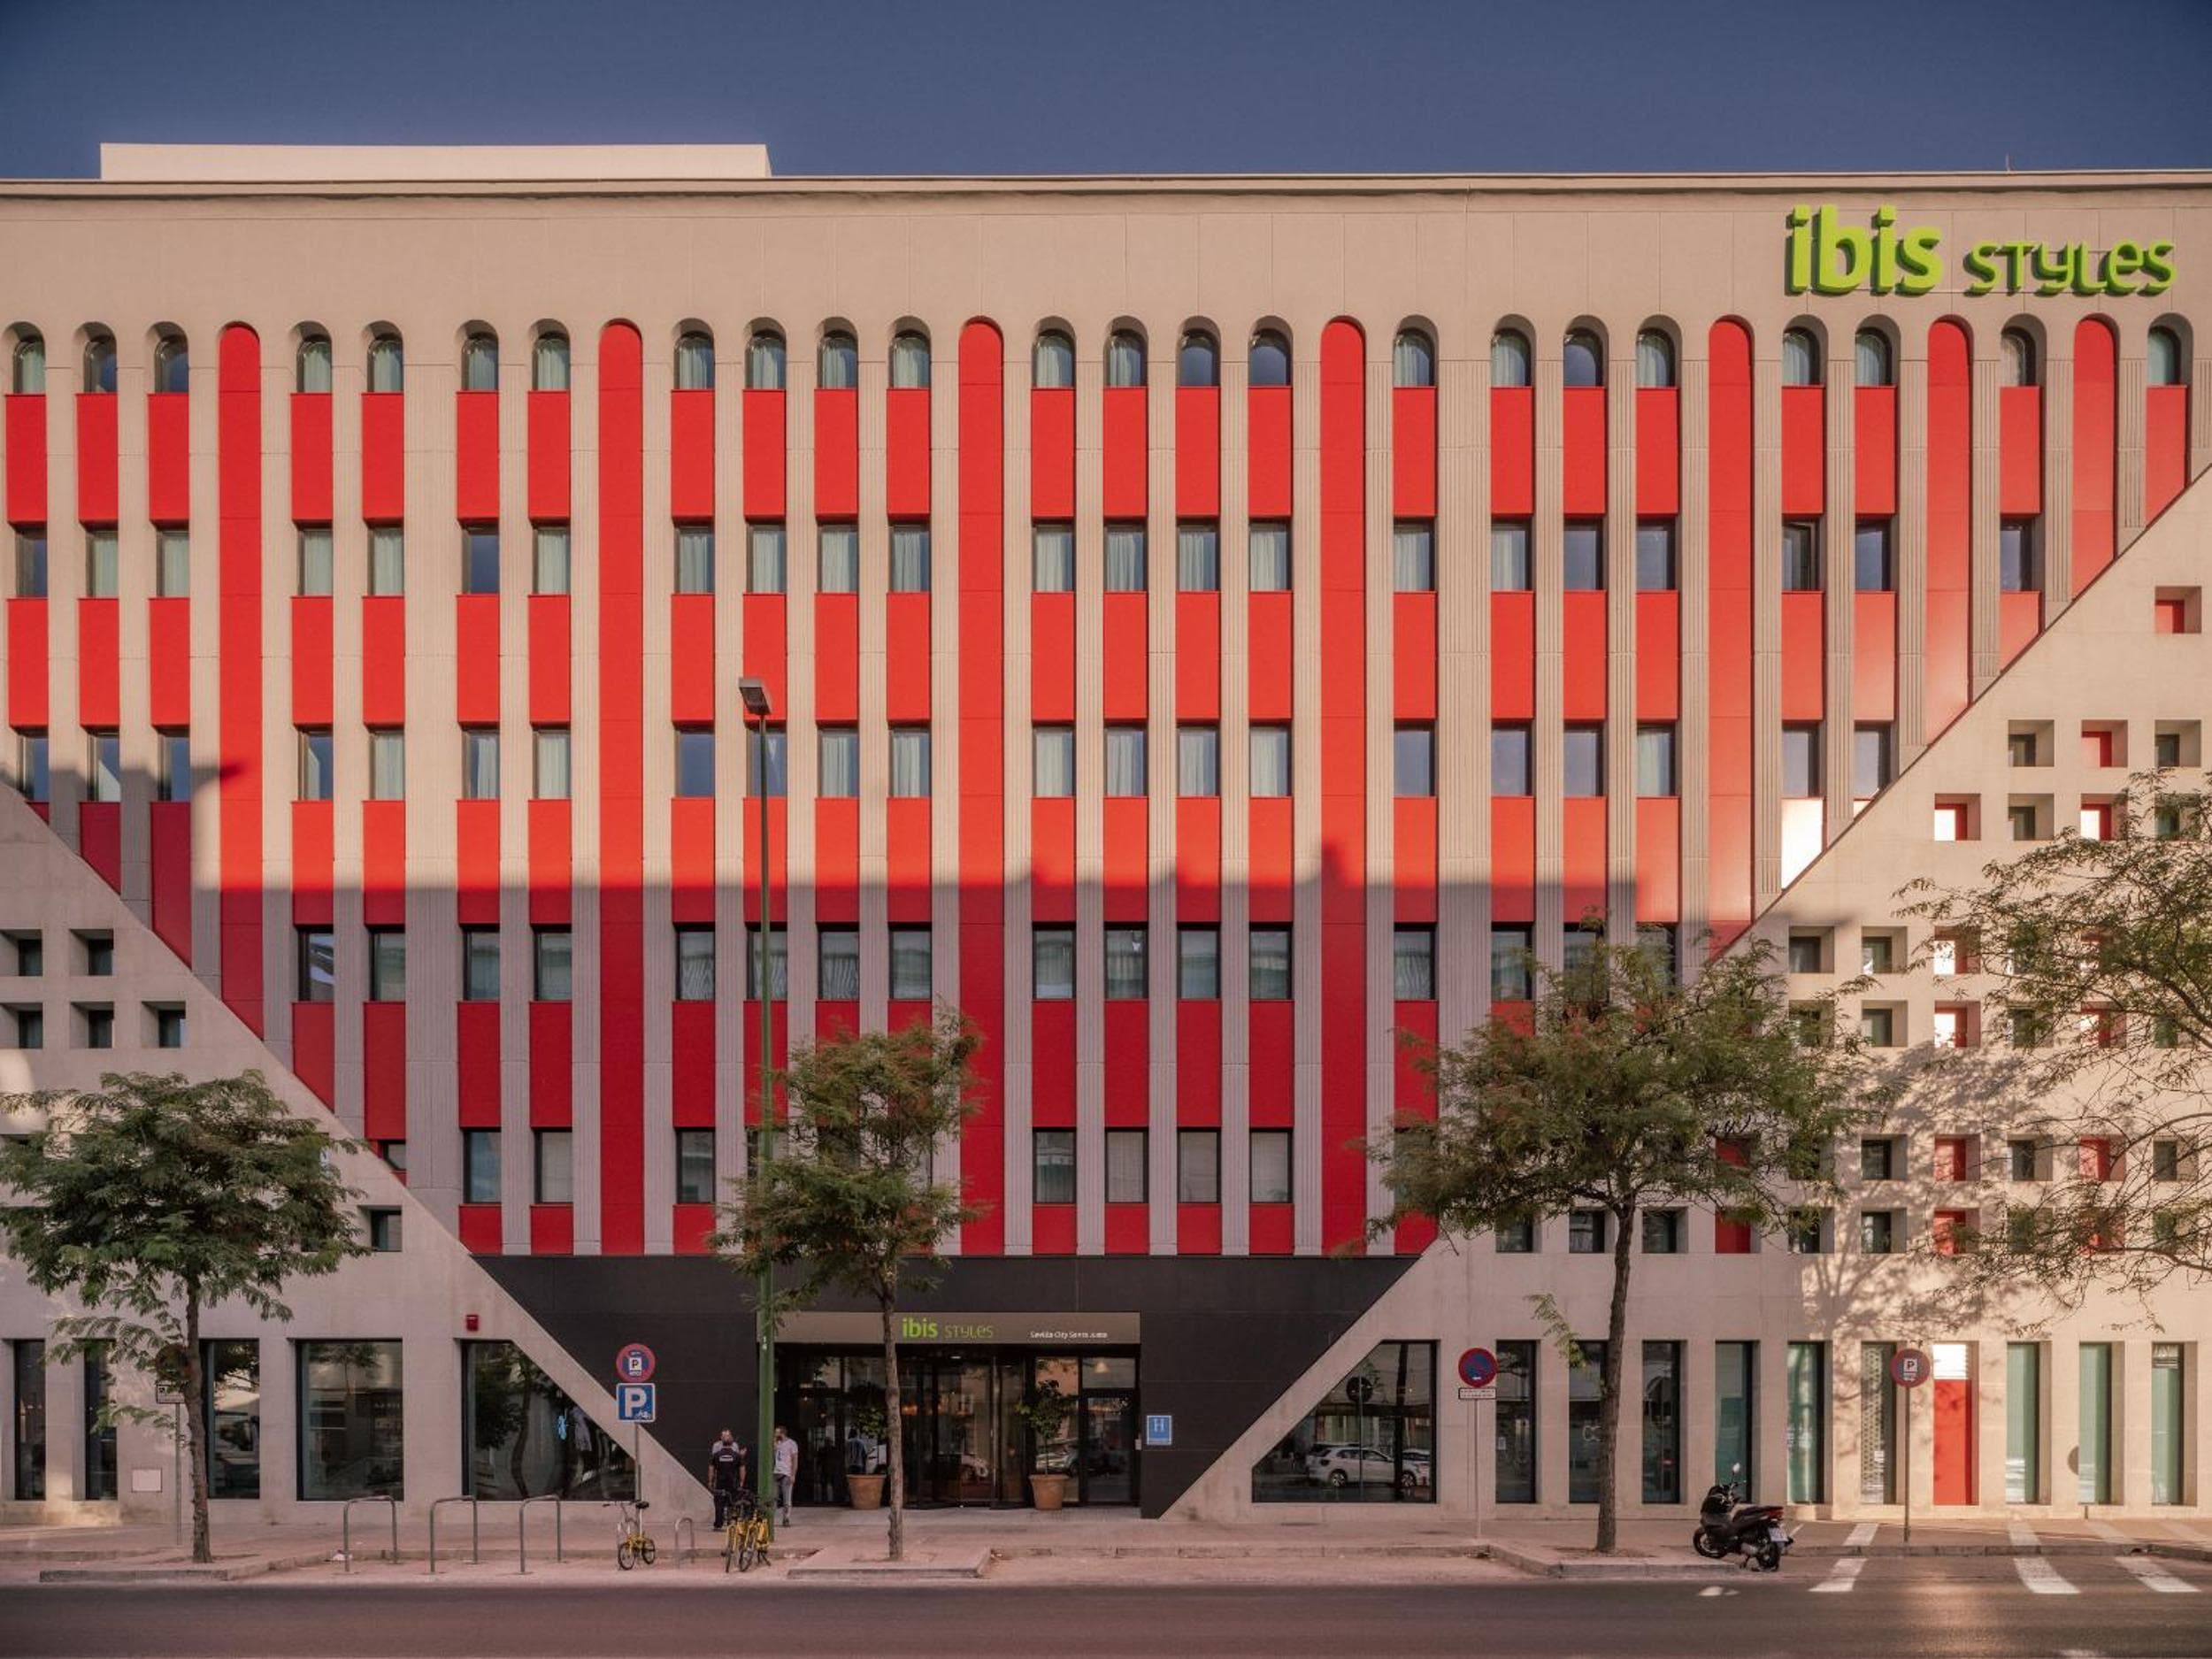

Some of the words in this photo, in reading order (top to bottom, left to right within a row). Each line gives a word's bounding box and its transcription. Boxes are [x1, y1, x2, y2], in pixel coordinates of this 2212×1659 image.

[1790, 204, 1942, 293] ibis
[902, 1317, 938, 1337] ibis
[632, 1359, 639, 1369] P
[1907, 1360, 1915, 1370] P
[625, 1387, 647, 1417] P
[1154, 1417, 1164, 1432] H
